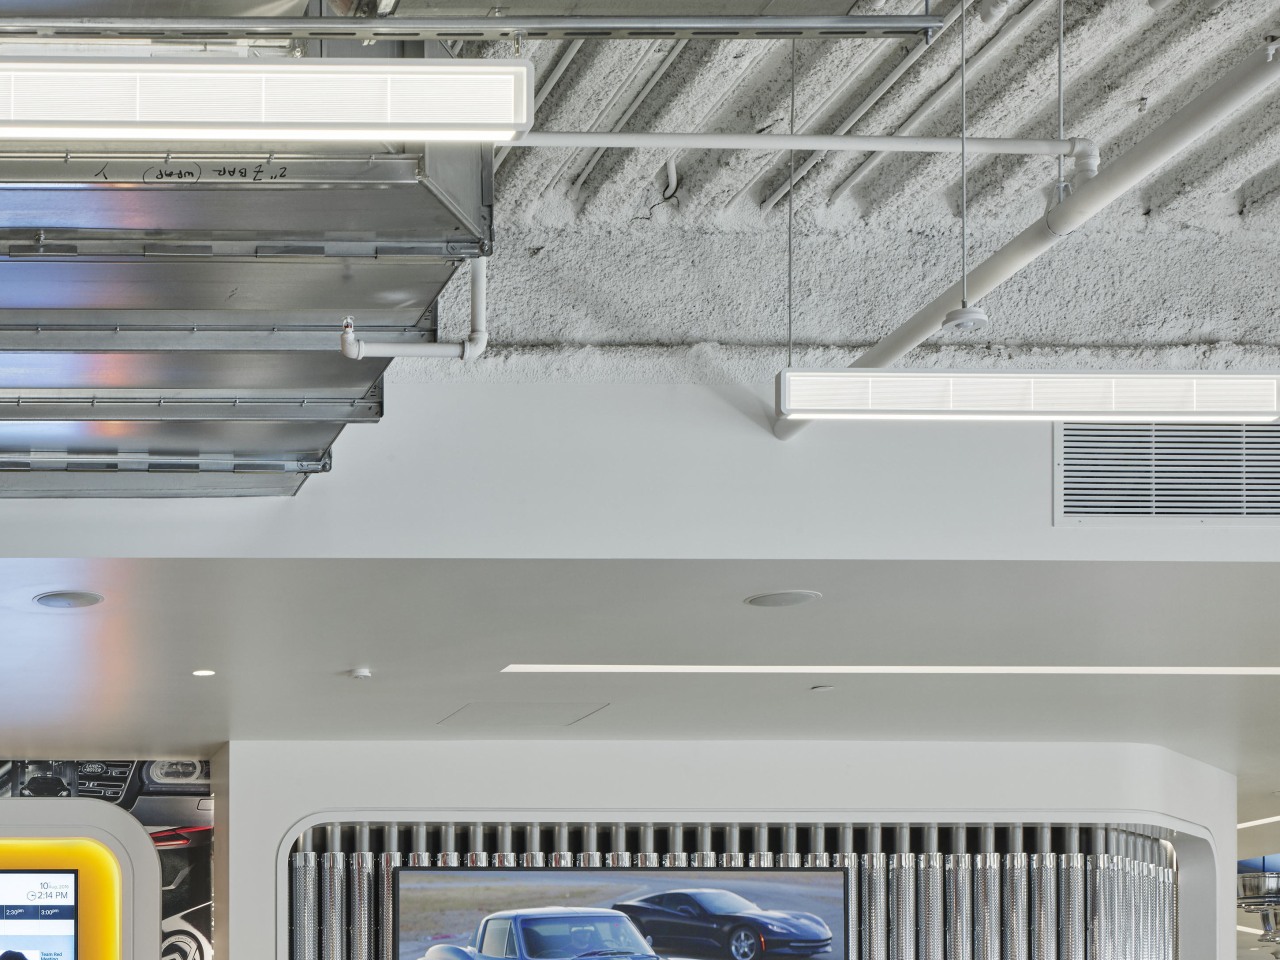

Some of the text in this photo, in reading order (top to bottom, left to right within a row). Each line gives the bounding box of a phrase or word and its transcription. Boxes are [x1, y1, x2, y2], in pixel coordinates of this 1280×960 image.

[212, 168, 247, 178] BAR
[40, 882, 48, 890] 10
[38, 891, 53, 899] 2:14
